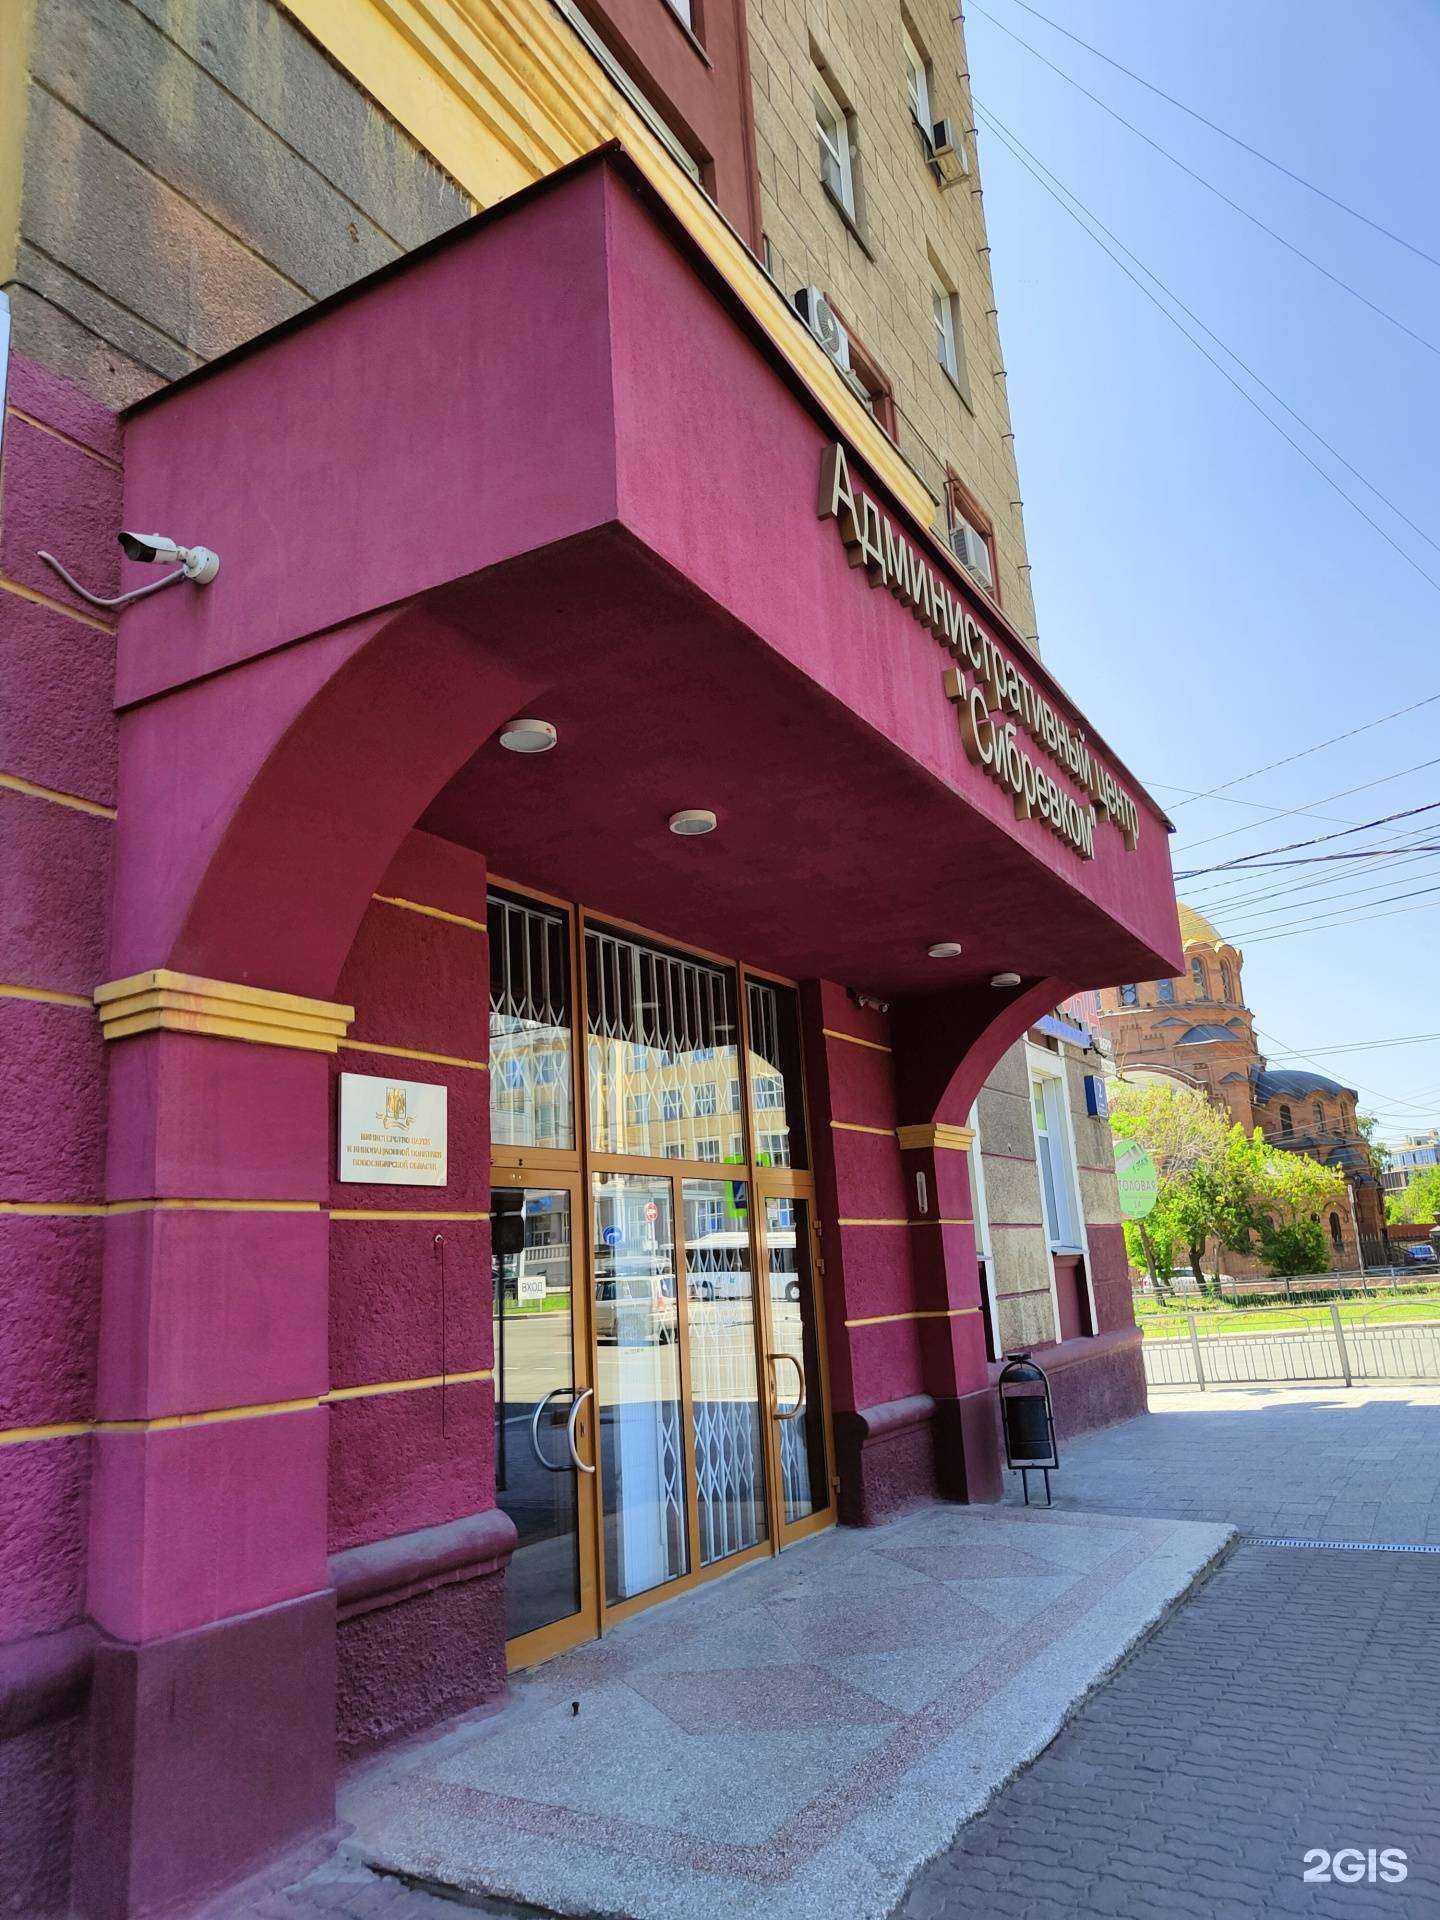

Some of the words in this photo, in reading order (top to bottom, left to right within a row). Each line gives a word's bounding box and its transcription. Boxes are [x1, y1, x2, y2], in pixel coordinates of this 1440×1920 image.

[827, 442, 1094, 790] Административный
[1094, 759, 1140, 841] центр
[521, 1281, 543, 1293] ВХОД
